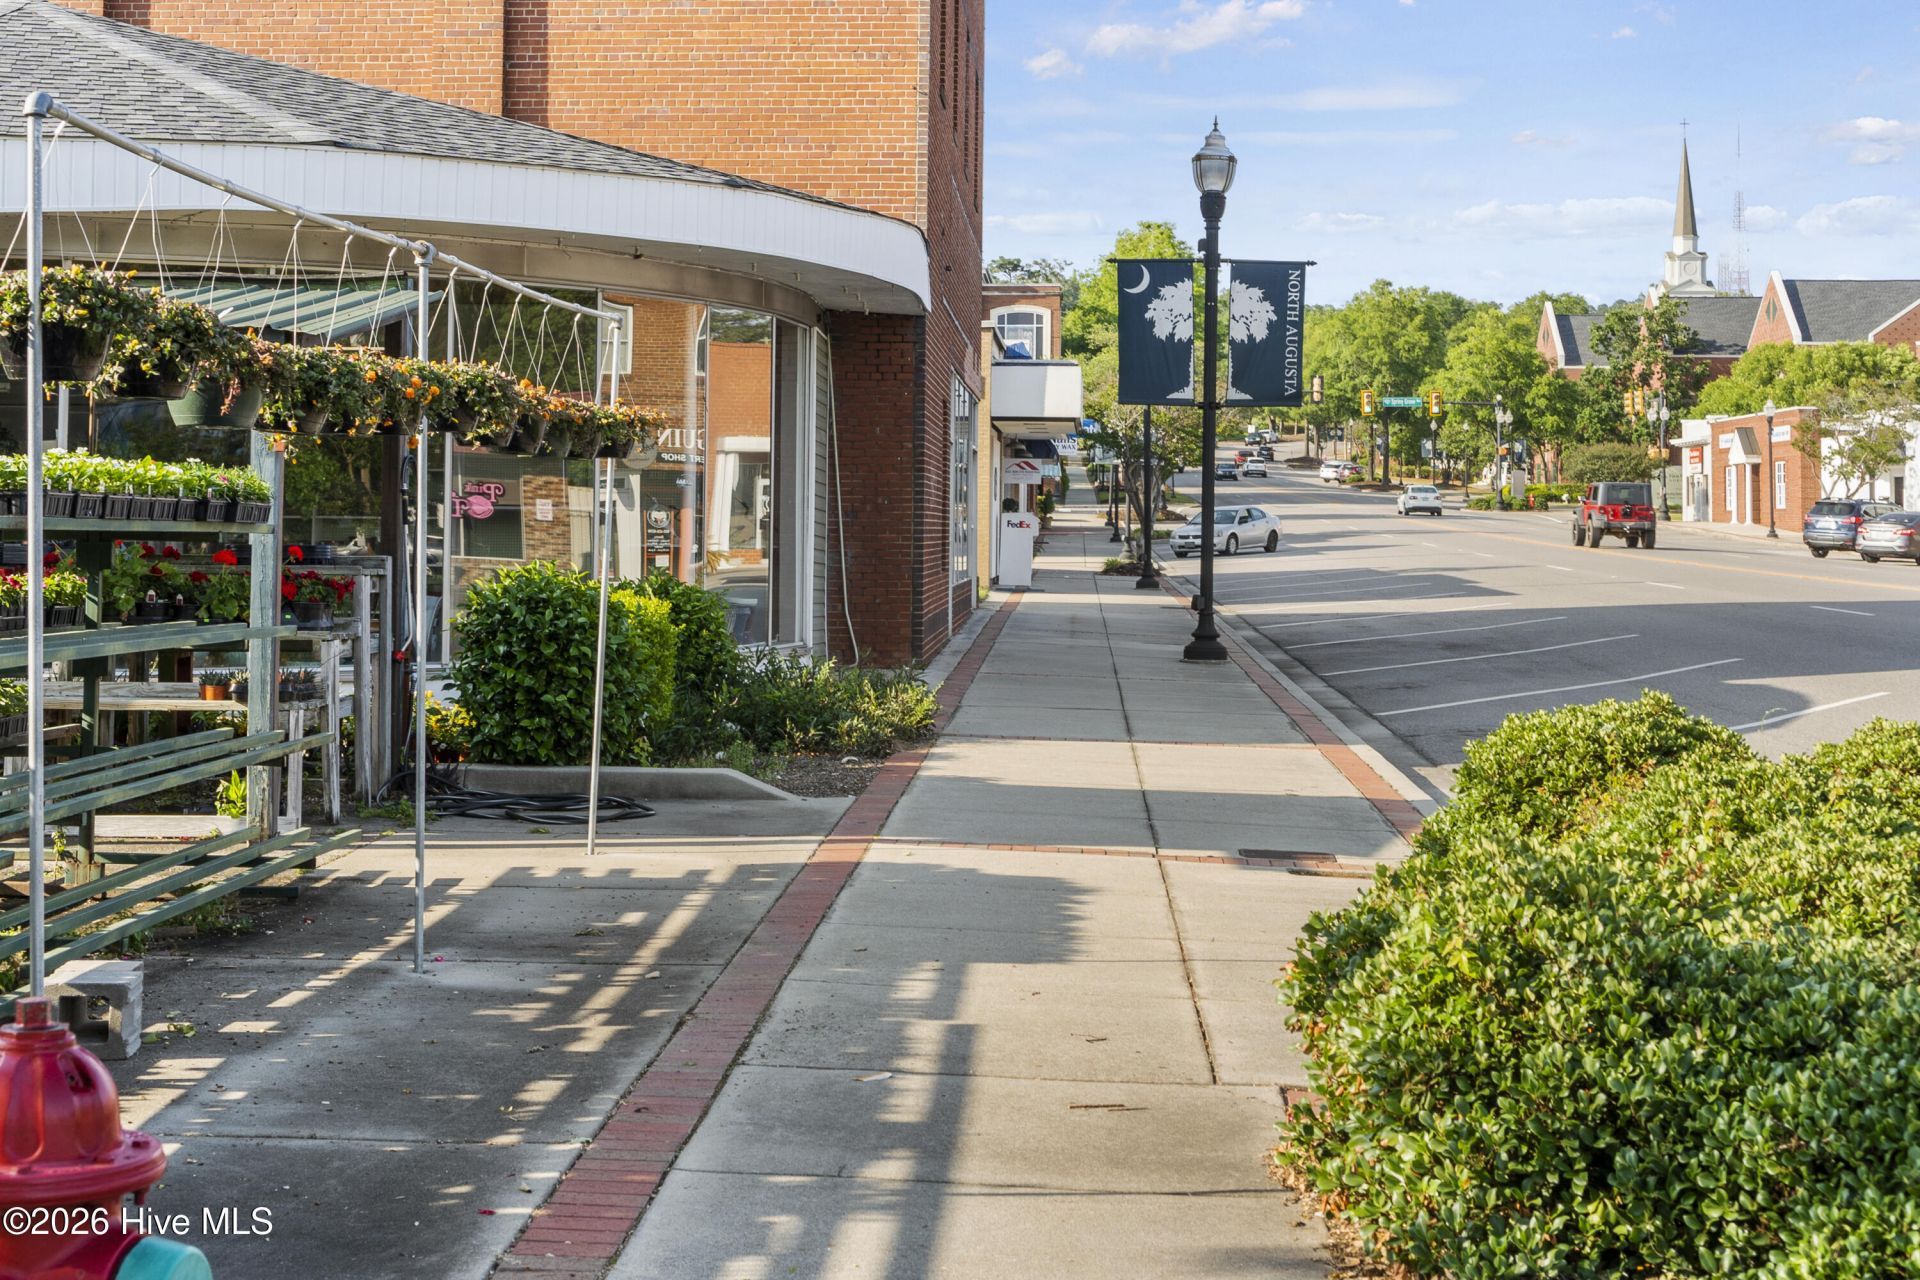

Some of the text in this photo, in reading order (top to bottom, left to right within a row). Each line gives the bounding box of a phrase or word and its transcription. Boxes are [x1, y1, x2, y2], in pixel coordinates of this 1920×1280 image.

[1284, 270, 1301, 397] NORTH AUGUSTA
[1007, 520, 1031, 528] FedEx
